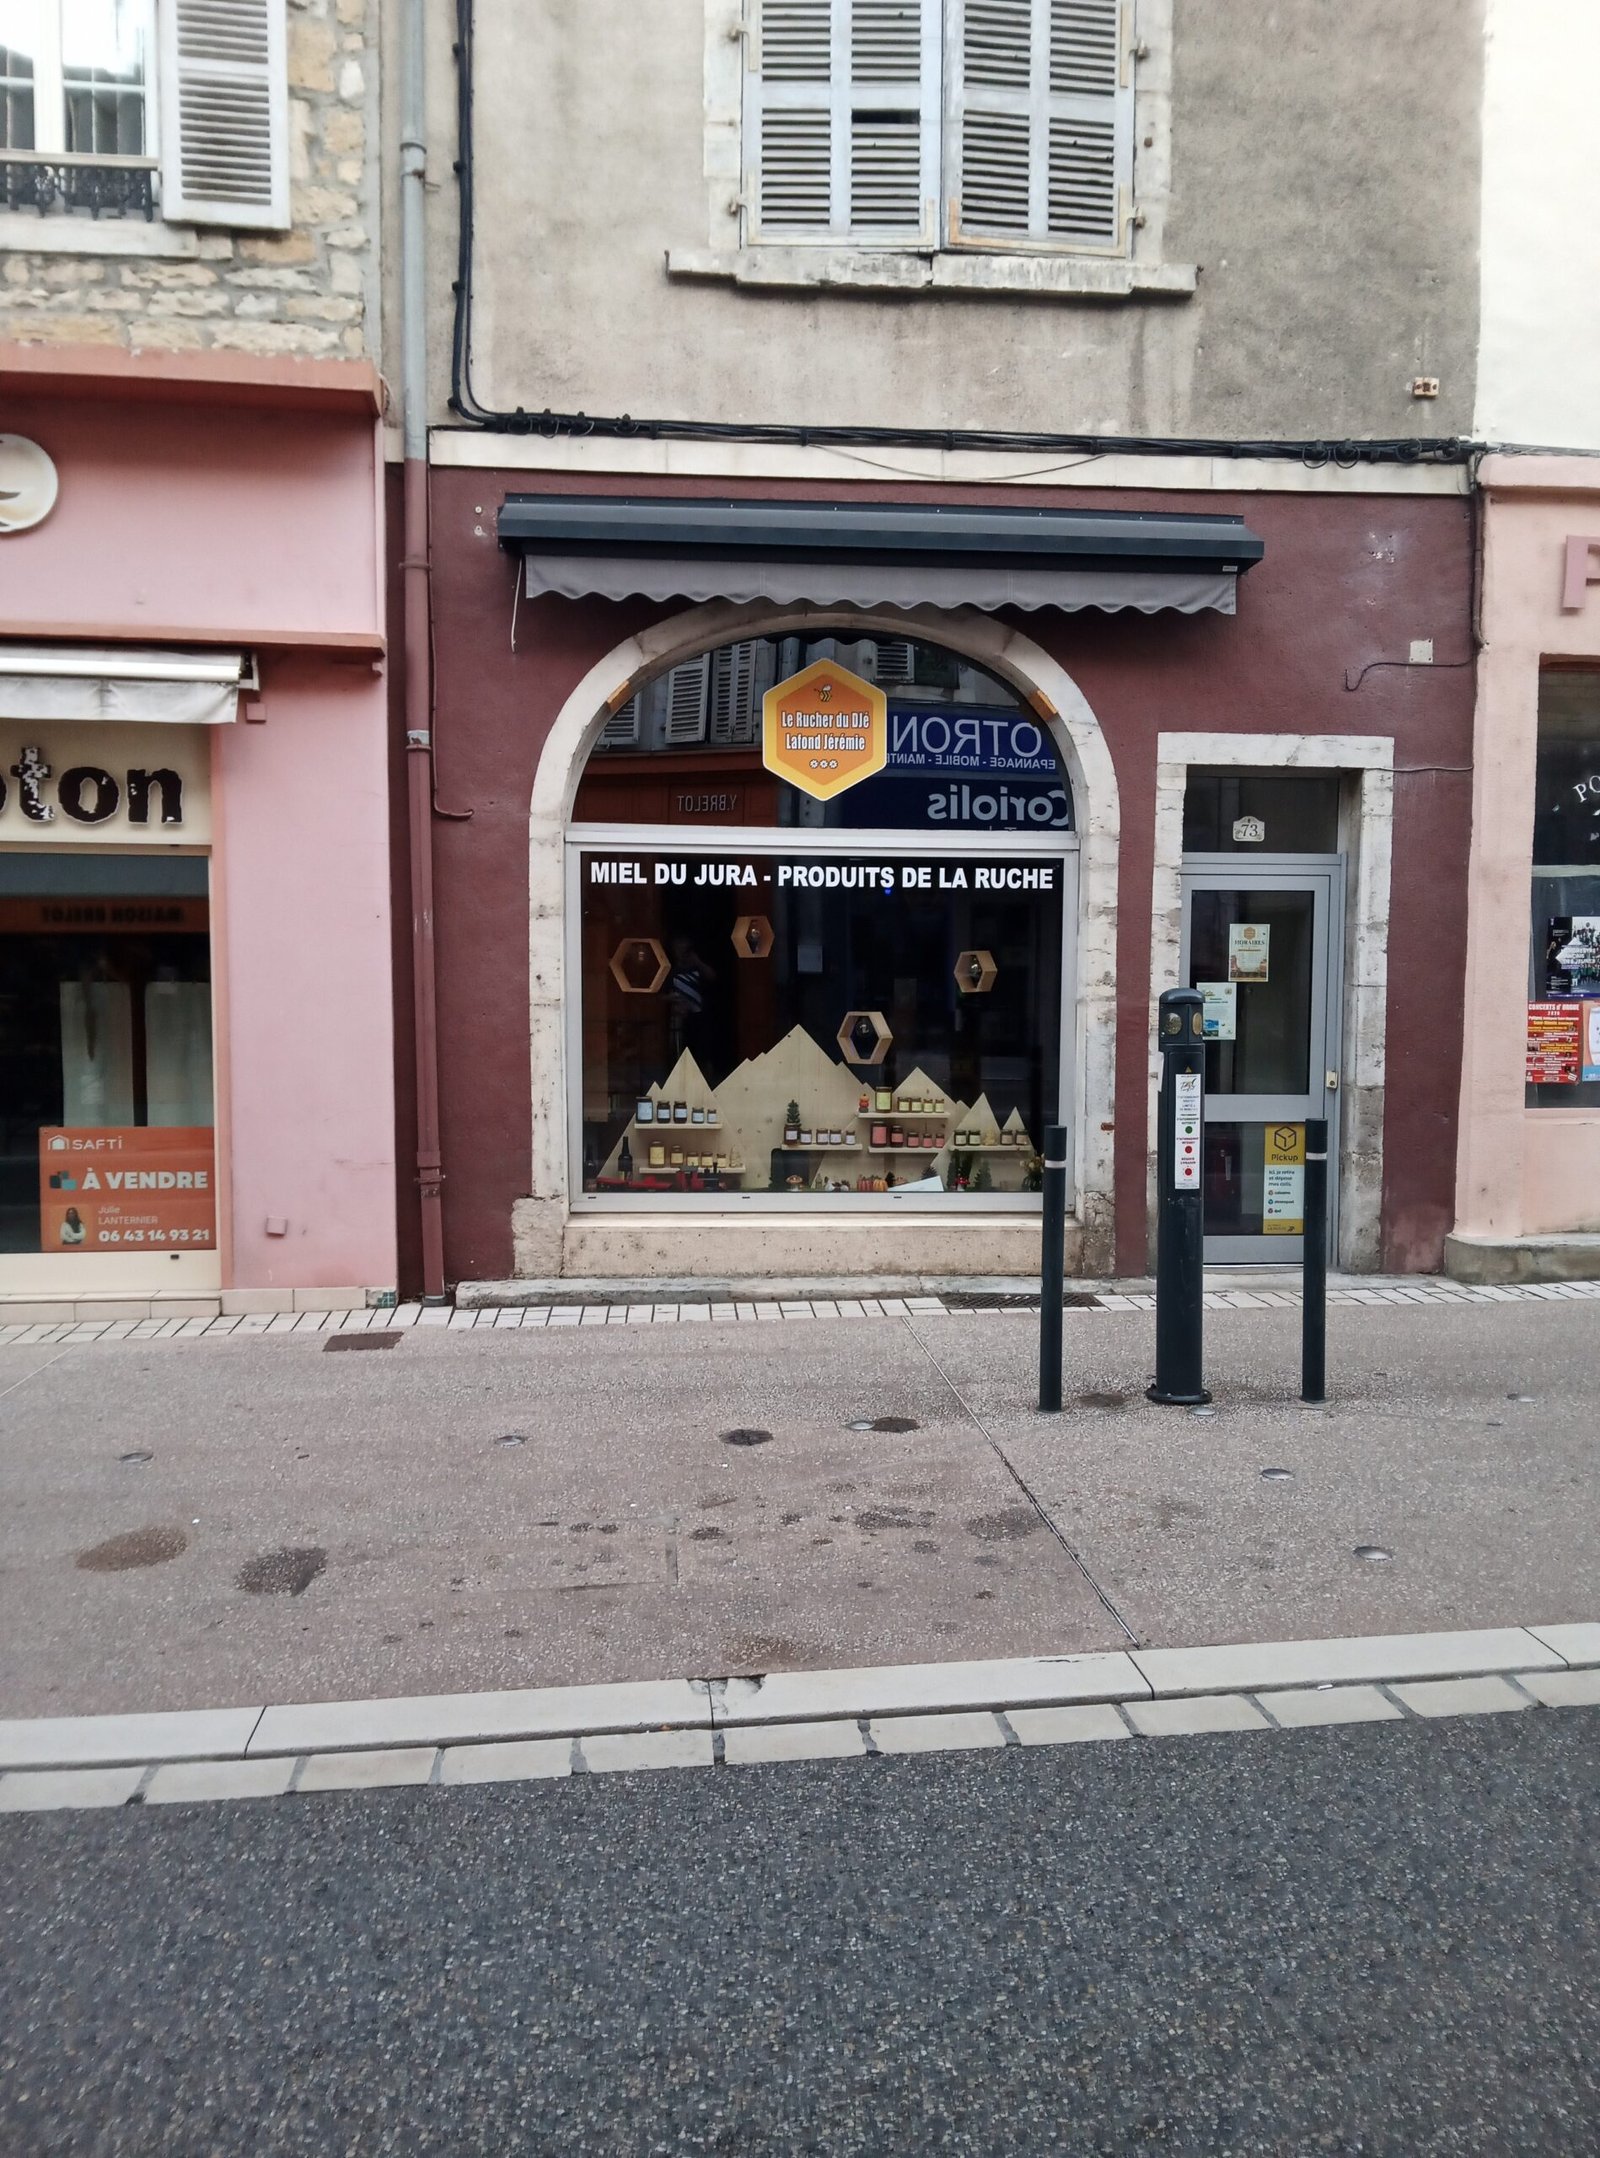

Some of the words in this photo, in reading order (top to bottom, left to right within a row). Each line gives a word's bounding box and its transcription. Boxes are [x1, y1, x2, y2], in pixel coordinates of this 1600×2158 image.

[782, 711, 793, 728] Le
[796, 711, 834, 728] Rucher
[836, 711, 849, 728] du
[851, 711, 869, 728] DJé
[786, 733, 821, 750] Lafond
[823, 733, 865, 750] Jérémie
[0, 747, 183, 824] ton
[1240, 823, 1259, 838] 73
[590, 861, 648, 885] MIEL
[654, 863, 687, 885] DU
[693, 864, 758, 886] JURA
[777, 865, 895, 888] PRODUITS
[902, 867, 932, 888] DE
[939, 868, 968, 889] LA
[975, 868, 1054, 889] RUCHE
[1271, 1153, 1299, 1162] Pickup
[82, 1167, 101, 1190] À
[104, 1171, 209, 1190] VENDRE
[98, 1206, 120, 1214] Julie
[98, 1230, 120, 1242] 06
[123, 1229, 145, 1242] 43
[147, 1229, 166, 1242] 14
[169, 1229, 189, 1241] 93
[192, 1229, 210, 1241] 21
